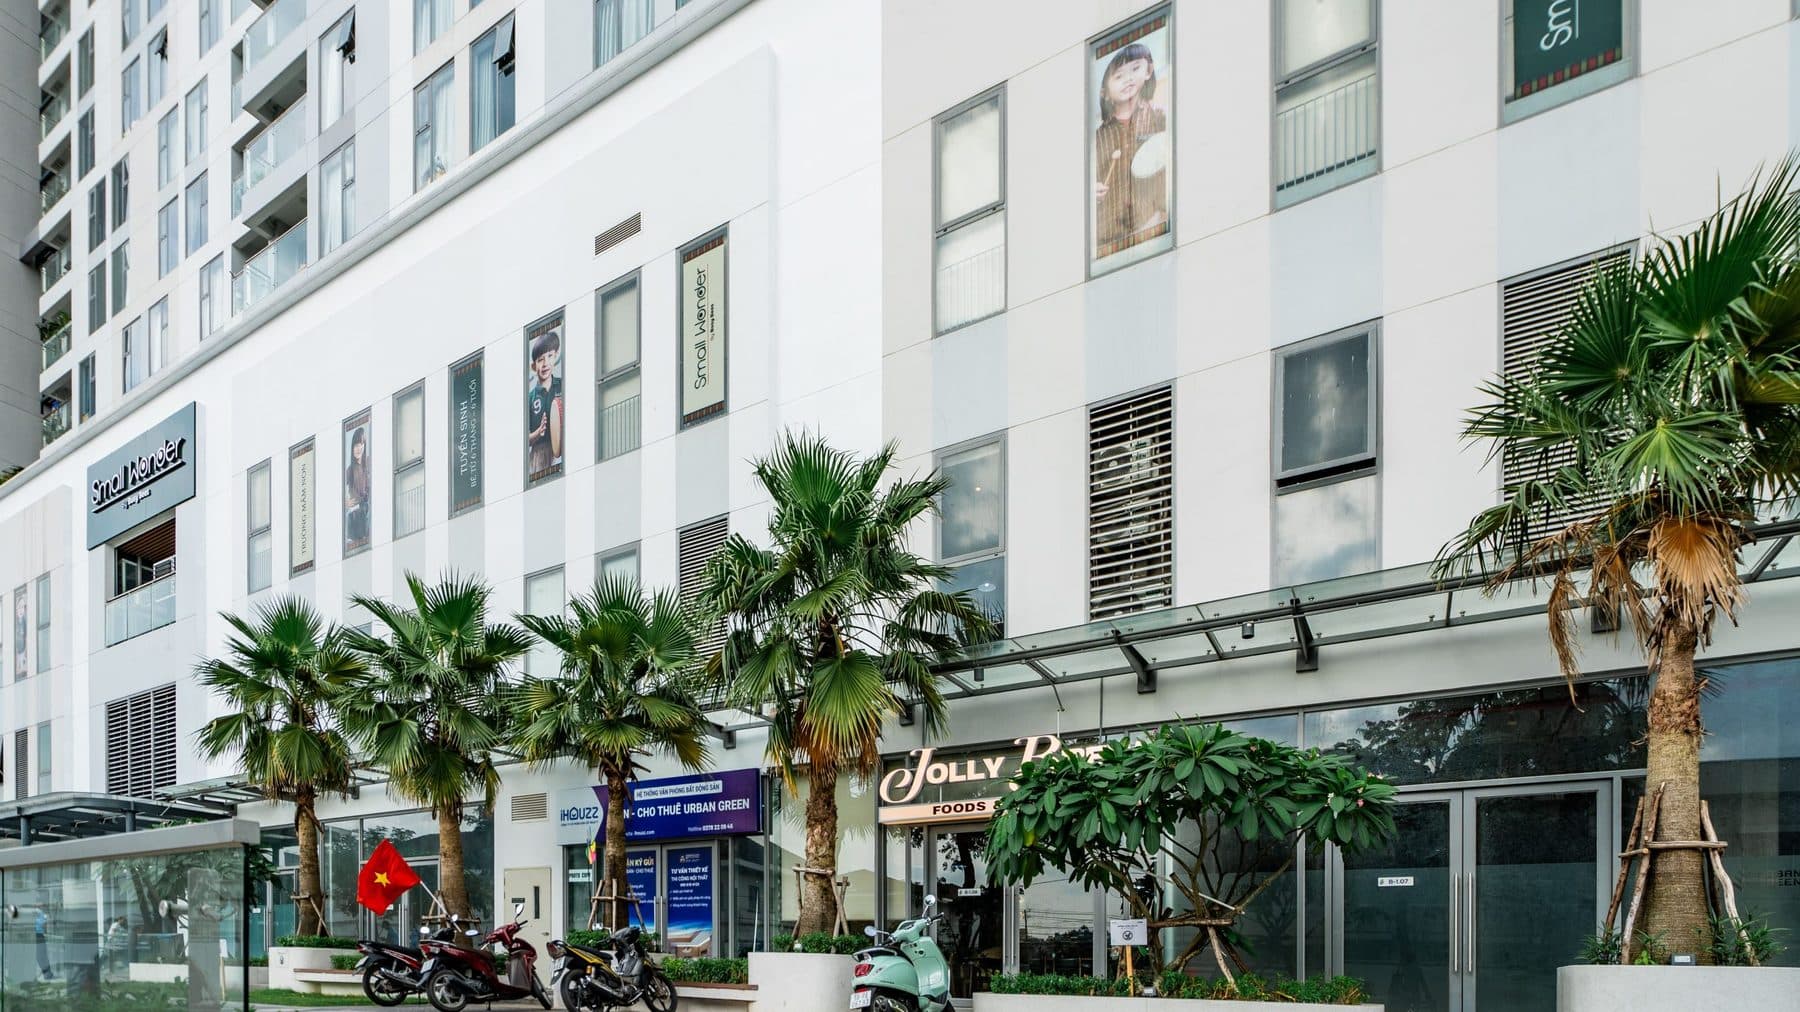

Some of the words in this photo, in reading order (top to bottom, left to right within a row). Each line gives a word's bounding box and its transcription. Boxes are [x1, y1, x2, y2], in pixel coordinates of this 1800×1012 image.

[694, 267, 707, 337] Wonder
[694, 340, 707, 390] Small
[459, 400, 468, 430] SINH
[92, 464, 128, 506] Small
[129, 437, 186, 487] Wonder
[880, 747, 1006, 804] JOLLY
[637, 806, 656, 818] CHO
[658, 802, 682, 817] THUÊ
[684, 800, 716, 814] URBAN
[718, 797, 750, 811] GREEN
[933, 801, 986, 815] FOODS
